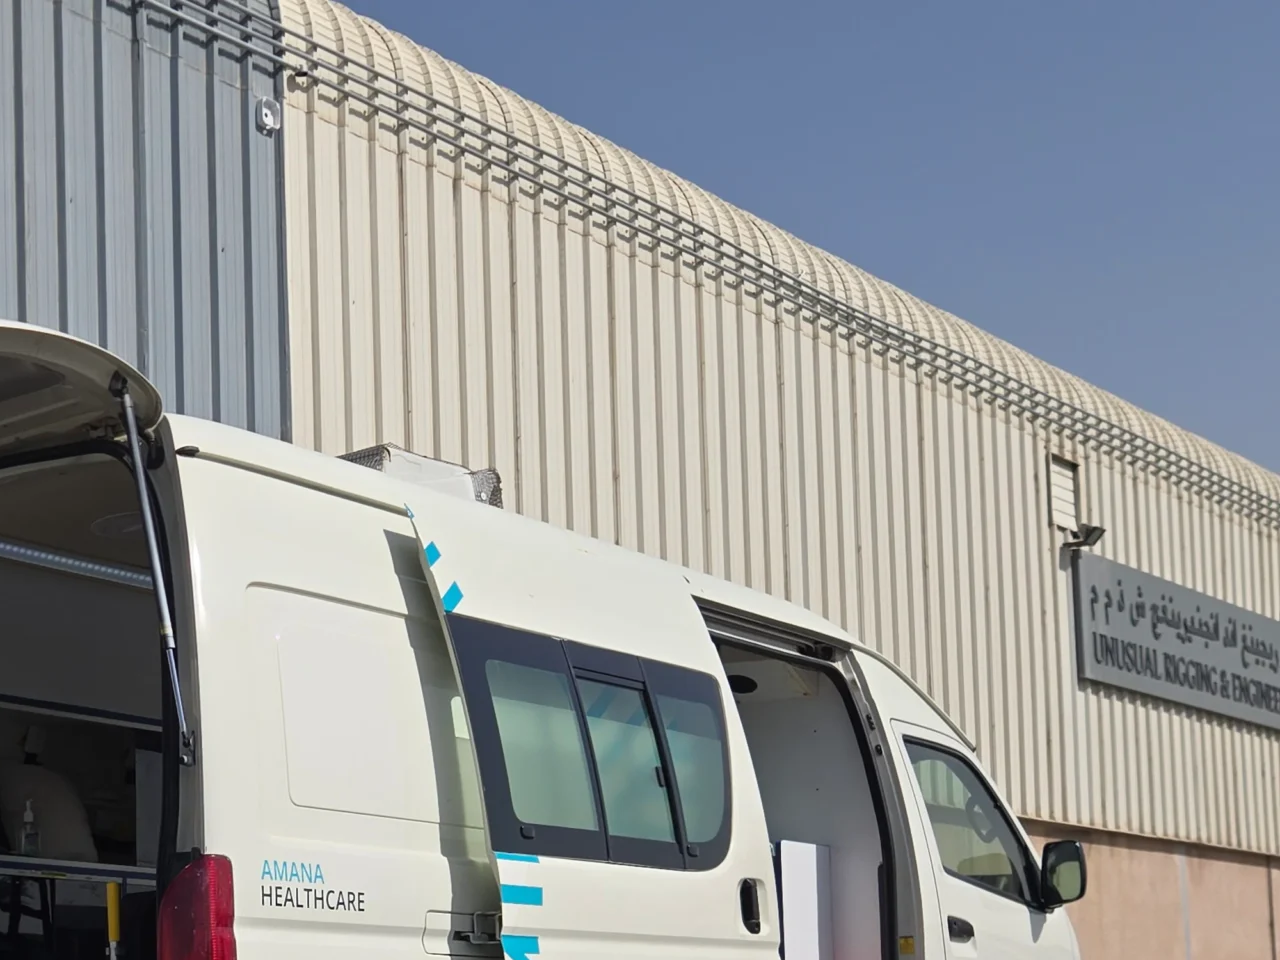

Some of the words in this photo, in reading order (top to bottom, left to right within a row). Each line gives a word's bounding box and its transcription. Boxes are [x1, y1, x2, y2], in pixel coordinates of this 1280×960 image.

[1092, 631, 1162, 682] UNUSUAL
[1162, 652, 1218, 696] RIGGING
[1220, 669, 1230, 700] &
[261, 859, 325, 884] AMANA
[261, 885, 365, 912] HEALTHCARE
